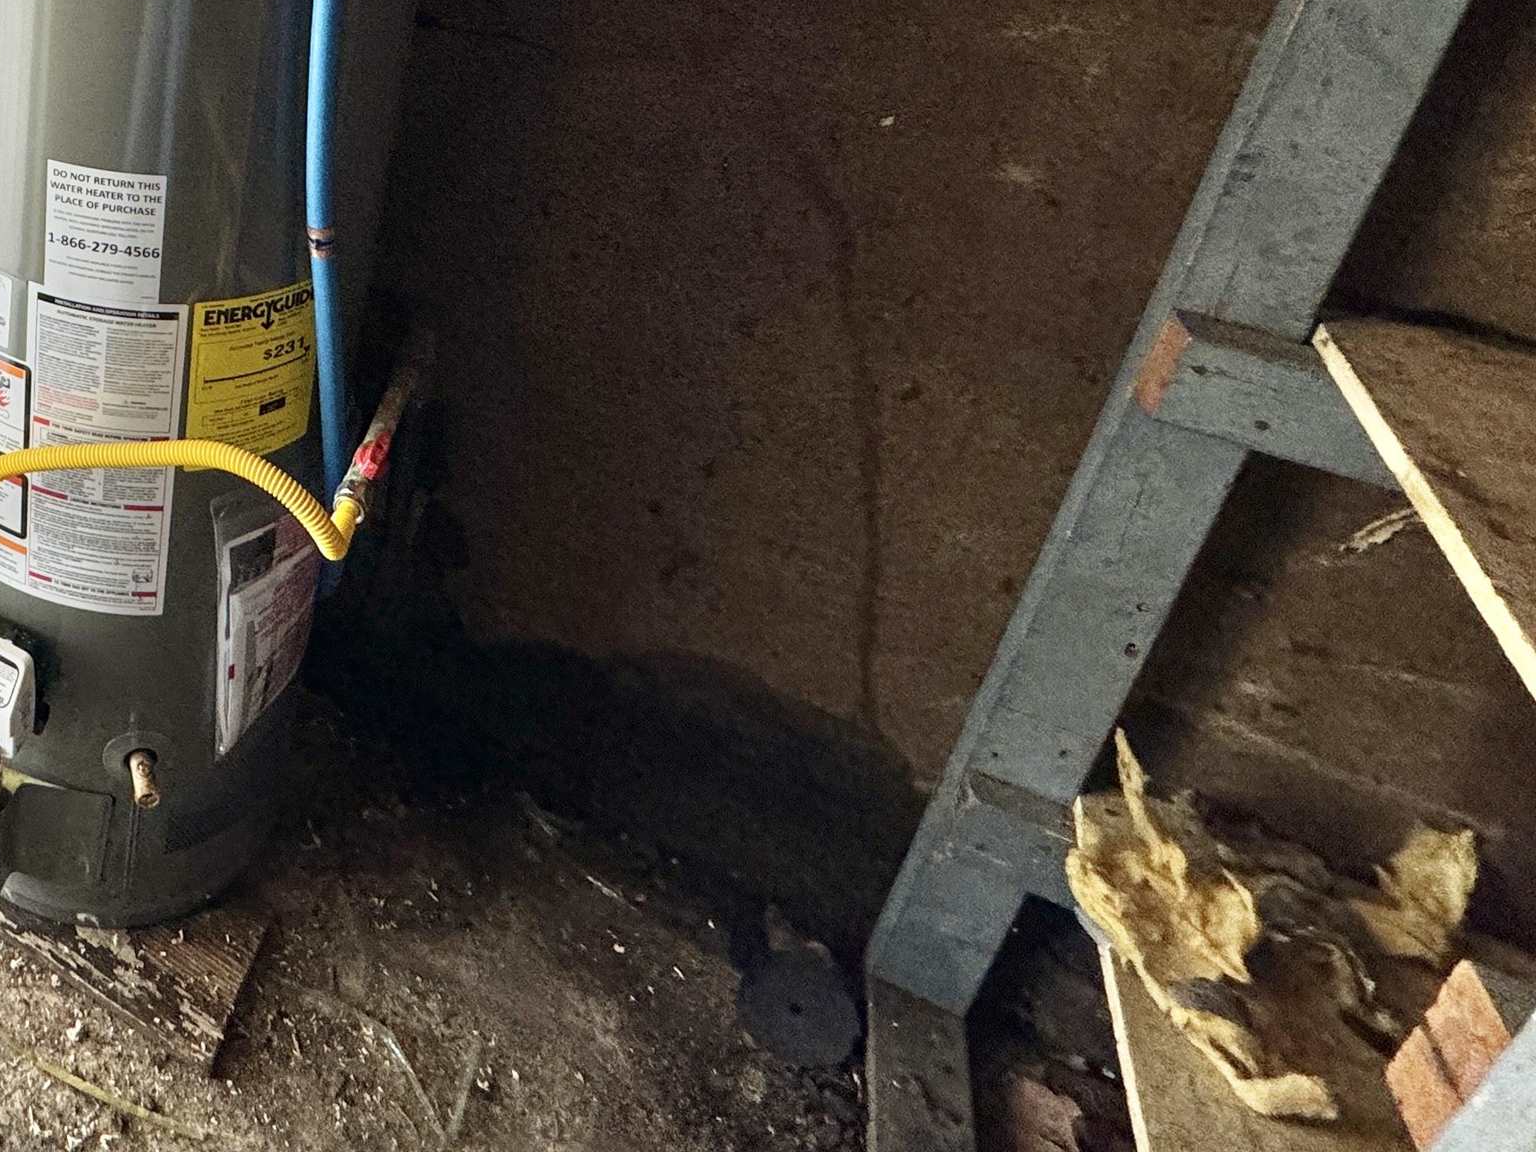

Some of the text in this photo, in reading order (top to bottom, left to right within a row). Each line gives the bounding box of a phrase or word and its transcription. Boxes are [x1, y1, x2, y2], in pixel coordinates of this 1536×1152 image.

[53, 168, 161, 191] DO NOT RETURN THIS
[50, 180, 163, 204] WATER HEATER TO THE
[54, 194, 156, 216] PLACE OF PURCHASE
[48, 231, 160, 259] 1-866-279-4566
[204, 289, 314, 329] ENERGYGUID
